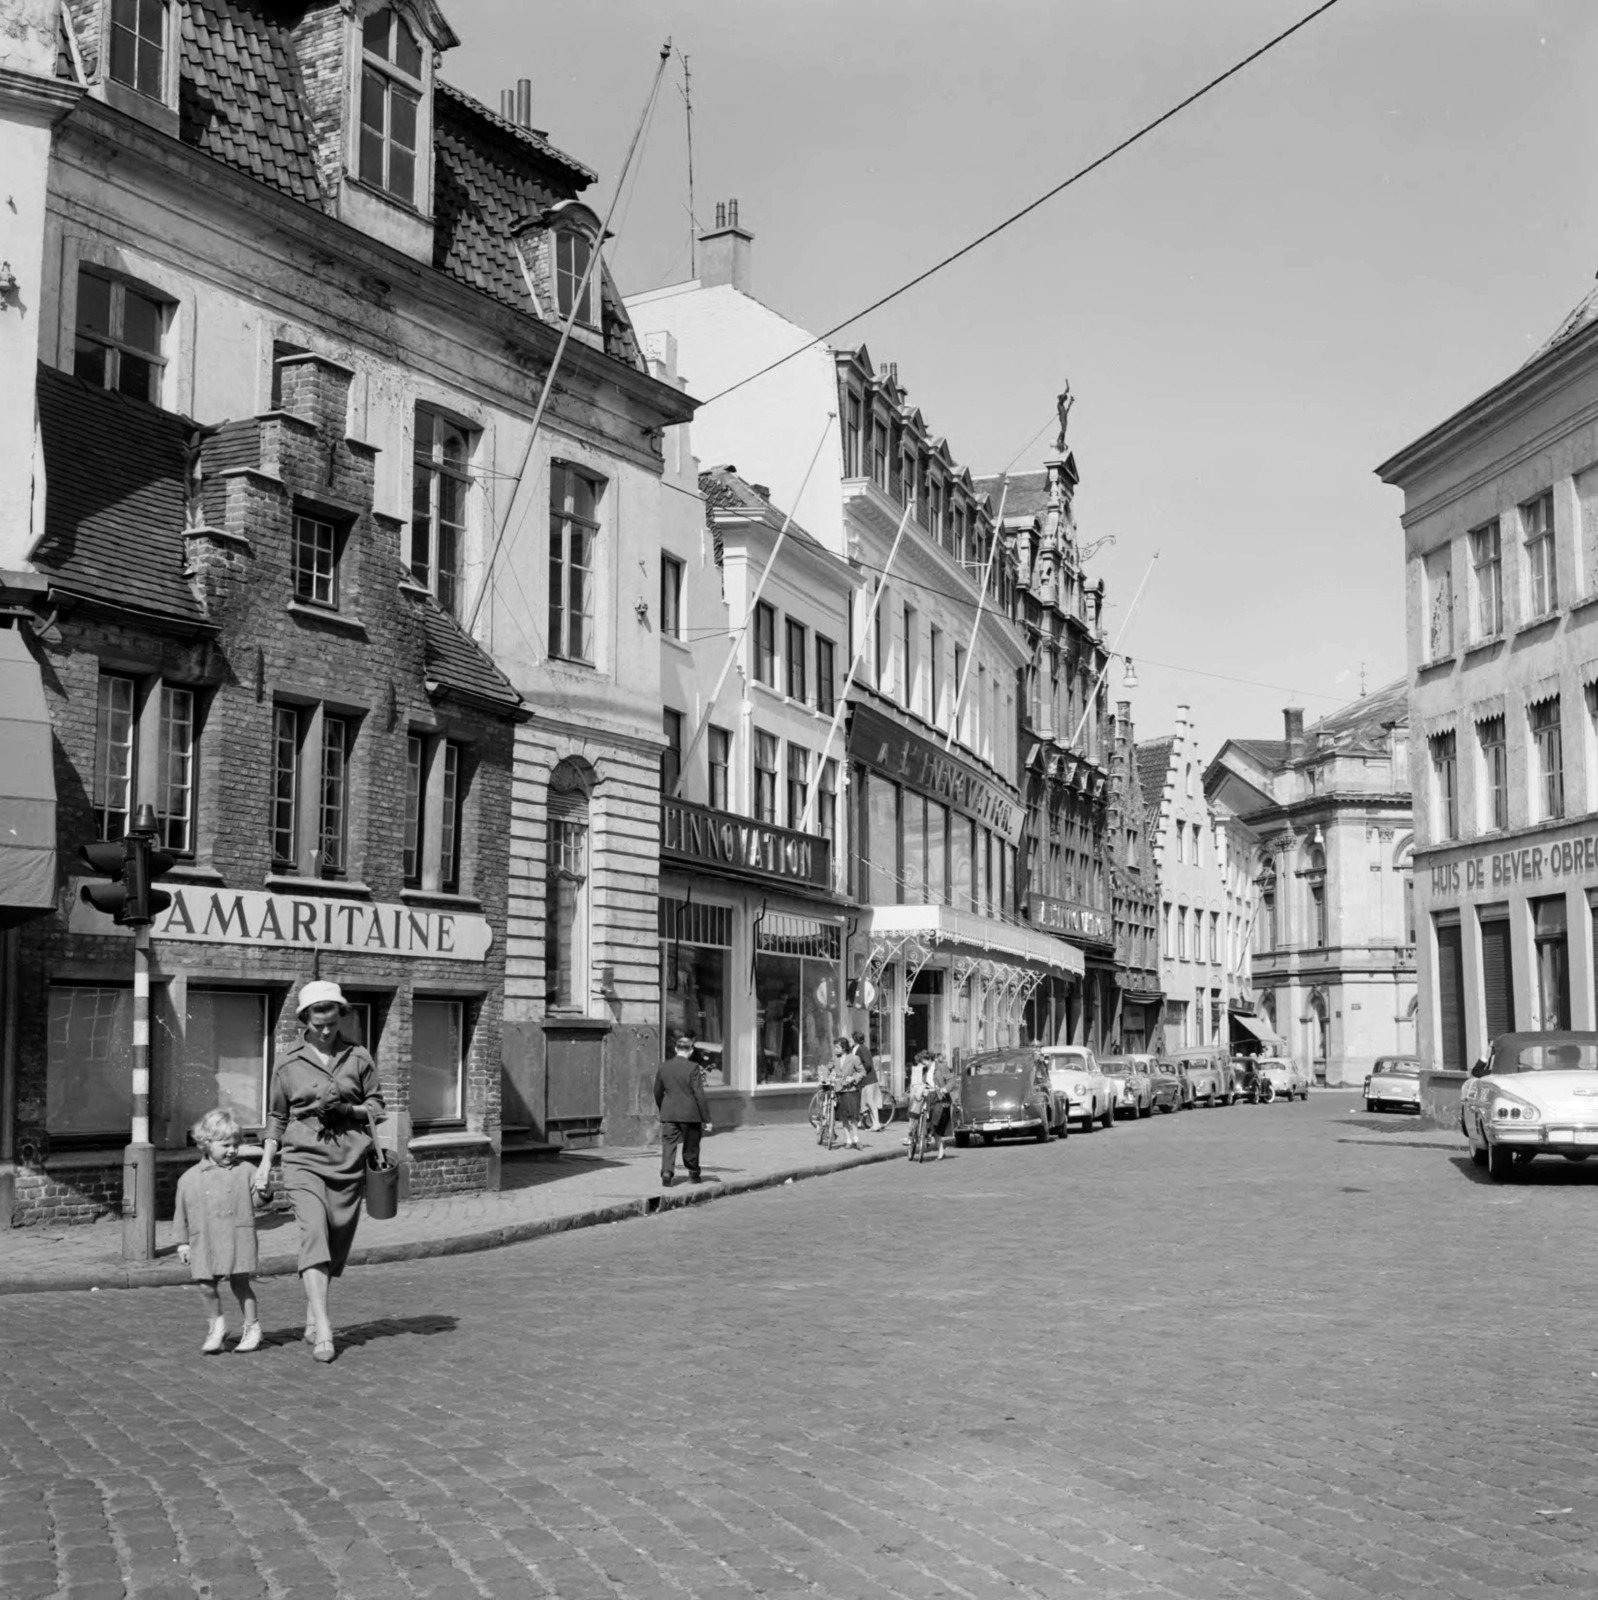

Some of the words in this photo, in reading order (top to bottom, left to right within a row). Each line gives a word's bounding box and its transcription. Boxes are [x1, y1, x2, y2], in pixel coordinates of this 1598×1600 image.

[663, 805, 812, 878] L'INNOVATION
[1431, 863, 1460, 895] HUIS
[1466, 858, 1484, 889] DE
[150, 889, 456, 952] AMARITAINE
